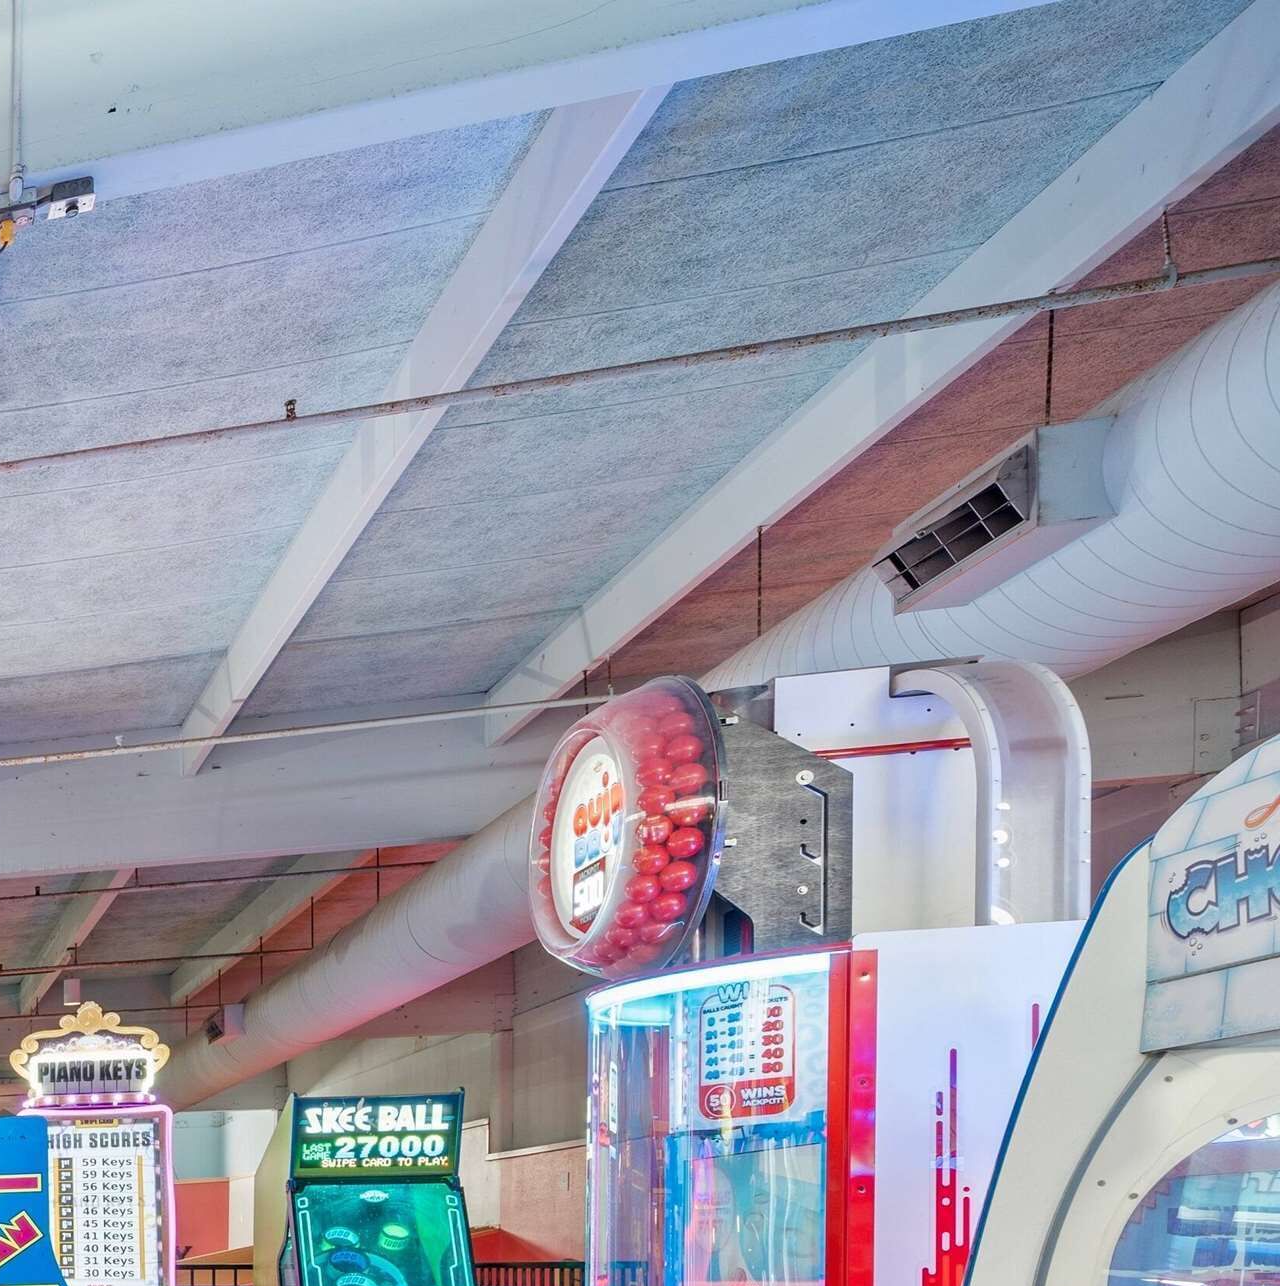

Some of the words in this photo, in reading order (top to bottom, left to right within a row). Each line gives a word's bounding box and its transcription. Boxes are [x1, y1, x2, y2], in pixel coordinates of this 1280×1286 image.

[762, 1020, 784, 1032] 20
[762, 1034, 784, 1046] 30
[762, 1048, 784, 1059] 40
[37, 1060, 95, 1083] PIANO
[100, 1058, 148, 1081] KEYS
[741, 1086, 786, 1101] WINS
[304, 1106, 372, 1134] SKEE
[378, 1103, 449, 1132] BALL
[48, 1133, 83, 1150] HIGH
[89, 1131, 152, 1149] SCORES
[303, 1144, 332, 1153] LAST
[335, 1134, 445, 1159] 27000
[303, 1152, 332, 1160] GAME
[82, 1158, 97, 1166] 59
[102, 1158, 132, 1168] Keys
[321, 1158, 357, 1168] SWIPE
[362, 1158, 392, 1168] CARD
[397, 1158, 413, 1167] TO
[82, 1170, 97, 1178] 59
[102, 1170, 133, 1180] Keys
[102, 1182, 133, 1192] Keys
[102, 1195, 133, 1204] Keys
[83, 1207, 98, 1215] 46
[103, 1207, 133, 1217] Keys
[103, 1219, 134, 1229] Keys
[103, 1232, 134, 1241] Keys
[83, 1244, 99, 1252] 40
[103, 1244, 134, 1254] Keys
[104, 1256, 134, 1266] Keys
[84, 1269, 99, 1277] 30
[104, 1269, 135, 1279] Keys
